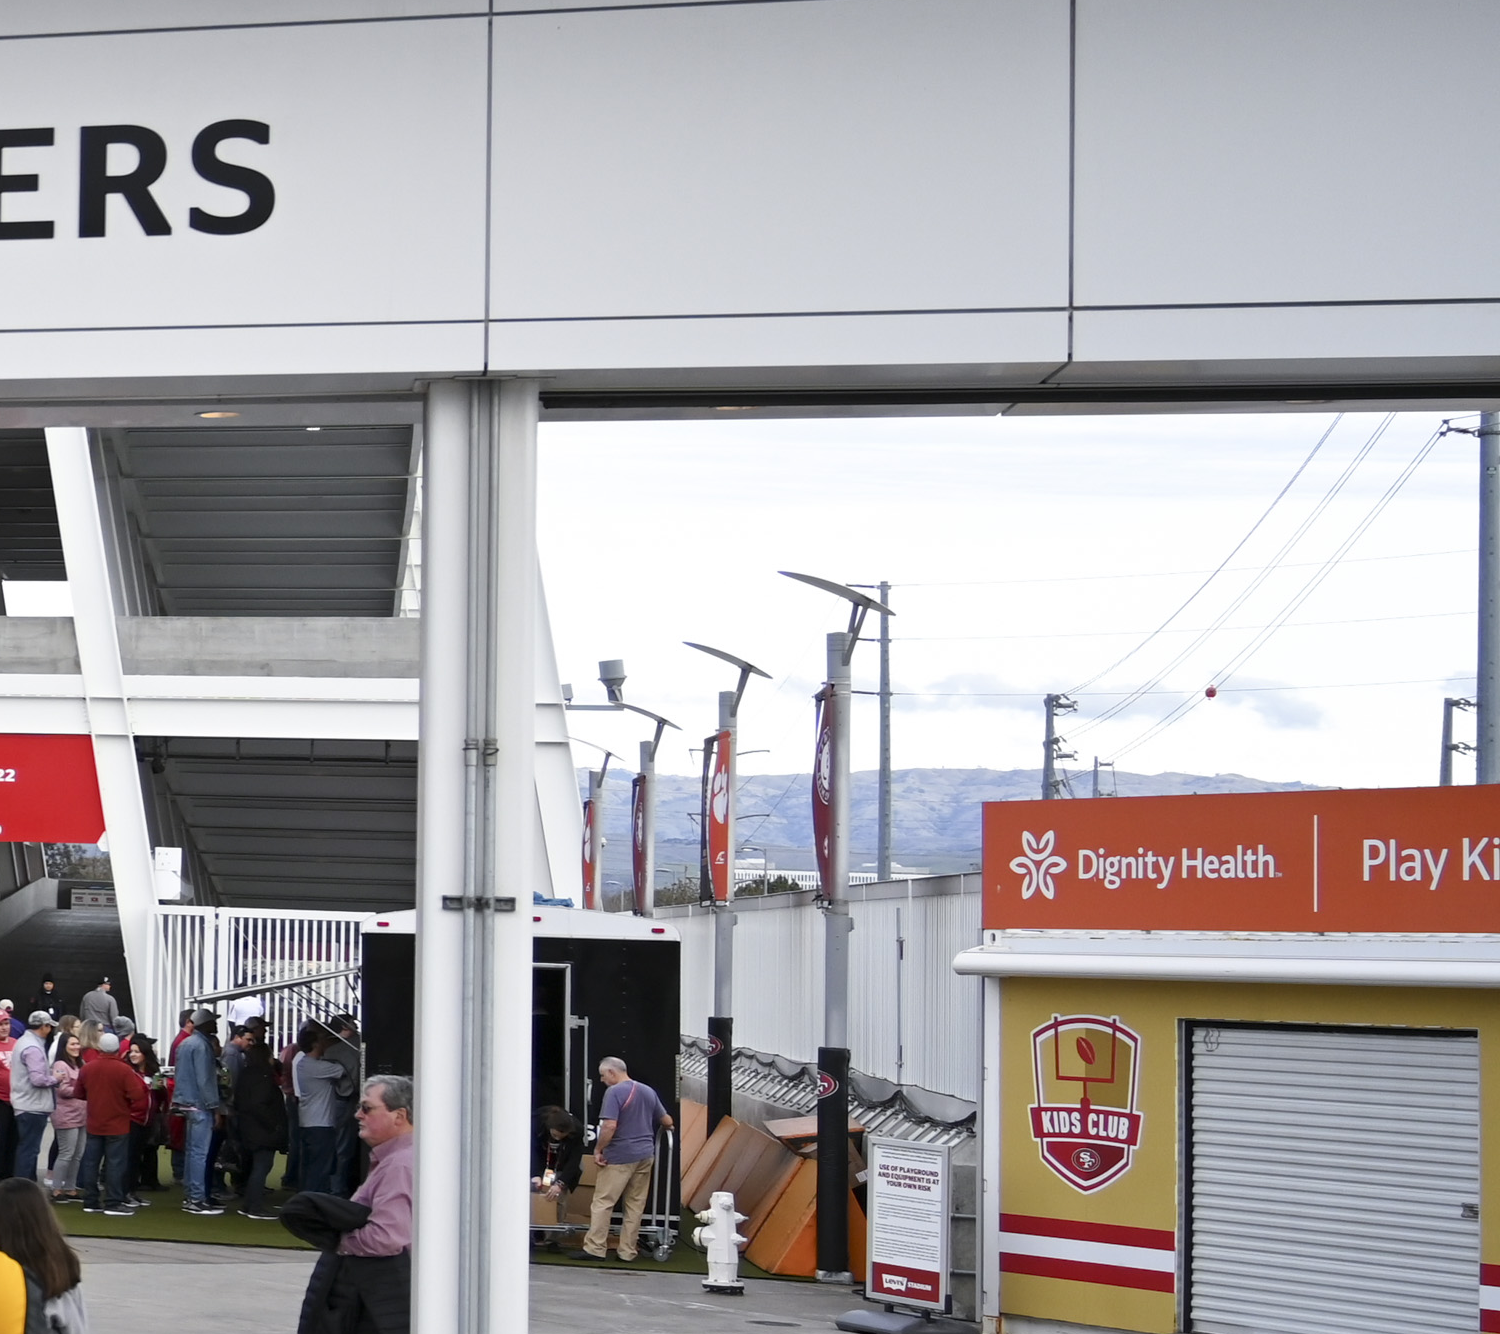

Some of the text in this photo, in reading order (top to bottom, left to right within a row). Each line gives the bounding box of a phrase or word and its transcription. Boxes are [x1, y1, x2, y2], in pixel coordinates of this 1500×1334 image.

[1077, 844, 1275, 890] Dignity Health
[1362, 838, 1449, 891] Play
[1041, 1111, 1129, 1140] KIDS CLUB
[877, 1171, 940, 1186] AND EQUIPMENT IS AT
[878, 1163, 890, 1171] USE
[899, 1166, 939, 1178] PLAYGROUND
[886, 1180, 932, 1192] YOUR OWN RISK
